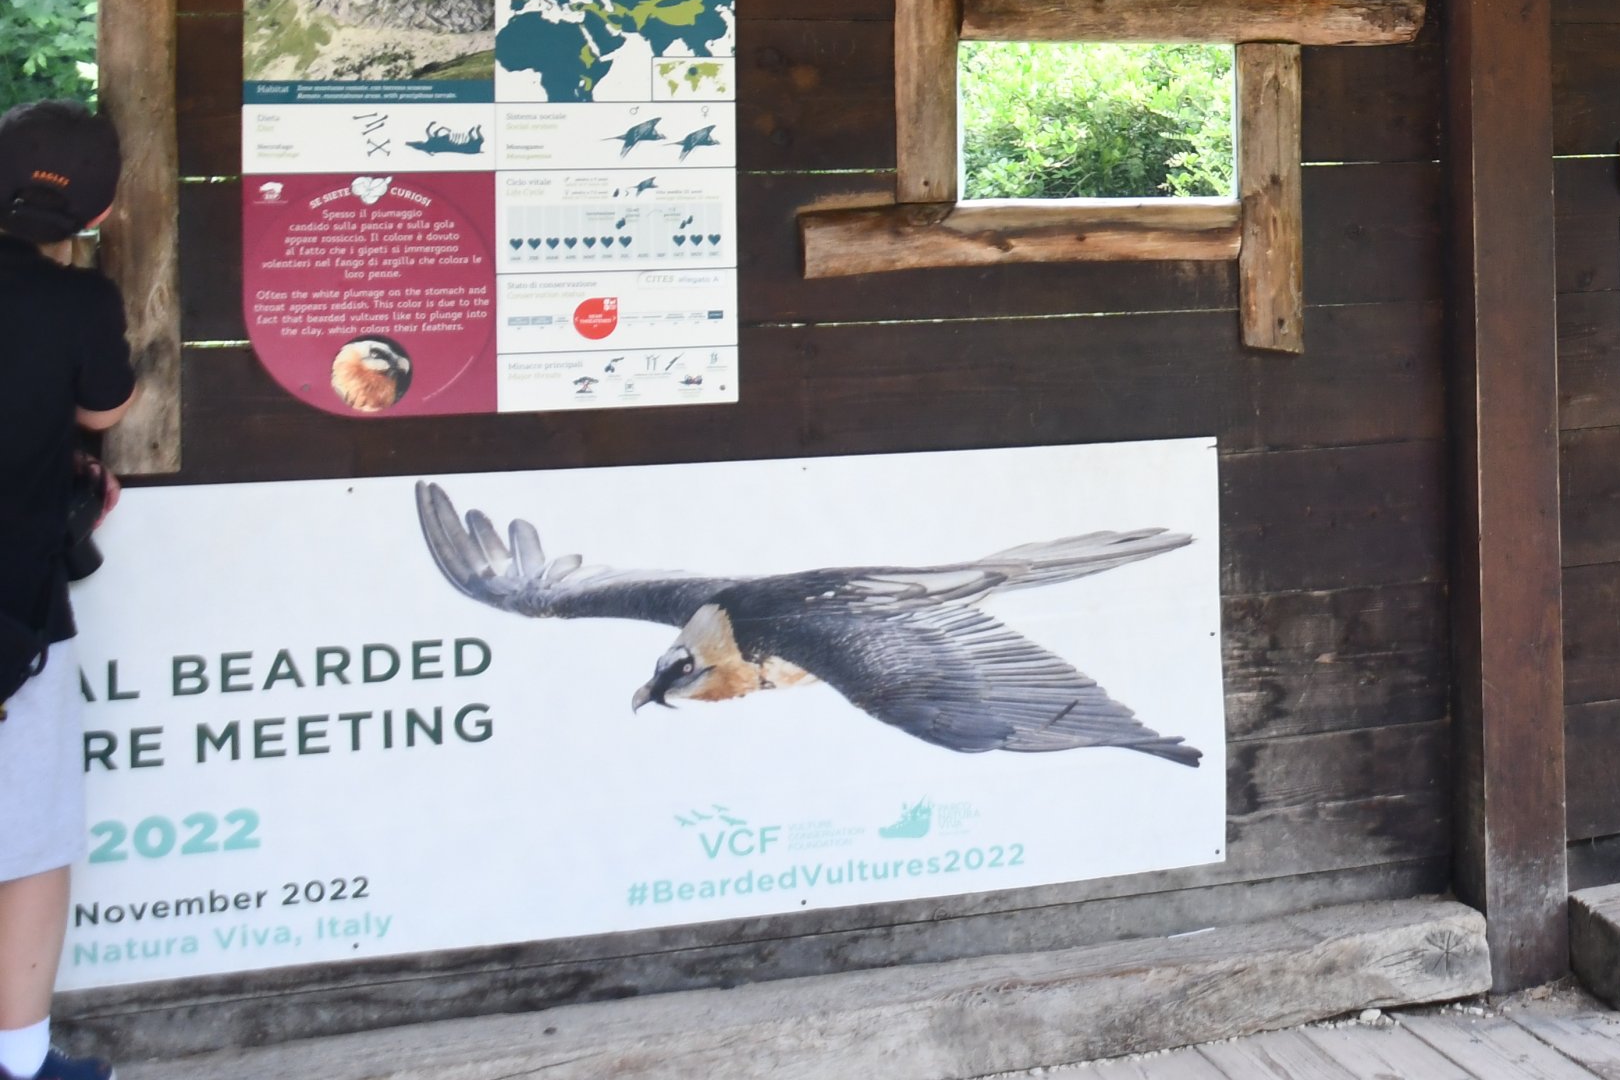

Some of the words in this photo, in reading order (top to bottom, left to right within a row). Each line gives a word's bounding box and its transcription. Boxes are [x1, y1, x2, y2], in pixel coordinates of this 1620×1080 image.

[257, 85, 289, 93] Habitat
[506, 113, 537, 121] Sistema
[506, 178, 527, 186] Ciclo
[529, 178, 551, 186] vitale
[310, 197, 322, 209] SE
[323, 187, 351, 202] SIETE
[390, 187, 432, 206] CURIOSI
[322, 210, 355, 221] Spesso
[360, 209, 367, 218] il
[371, 209, 423, 220] piumaggio
[289, 222, 330, 231] candido
[333, 222, 356, 230] sulla
[361, 222, 393, 232] pancia
[407, 220, 430, 229] sulla
[434, 220, 455, 230] gola
[285, 236, 317, 246] appare
[321, 234, 366, 243] rossiccio.
[371, 233, 378, 241] Il
[384, 232, 413, 241] colore
[426, 232, 460, 240] dovuto
[286, 247, 295, 256] al
[300, 247, 326, 255] fatto
[329, 246, 346, 254] che
[358, 246, 387, 256] gipeti
[404, 245, 458, 255] immergono
[262, 259, 310, 269] volentieri
[315, 258, 330, 267] nel
[335, 257, 364, 268] fango
[368, 258, 378, 266] di
[383, 256, 415, 268] argilla
[419, 256, 435, 264] che
[439, 256, 469, 264] colora
[473, 255, 482, 263] le
[344, 270, 364, 279] loro
[368, 271, 401, 281] penne.
[645, 275, 674, 283] CITES
[507, 281, 527, 290] Stato
[529, 280, 536, 289] di
[537, 280, 597, 290] conservazione
[256, 290, 287, 300] Often
[292, 290, 308, 299] the
[312, 290, 339, 298] white
[344, 289, 384, 300] plumage
[405, 288, 421, 296] the
[425, 287, 465, 295] stomach
[469, 286, 486, 294] and
[254, 304, 285, 312] throat
[290, 303, 327, 313] appears
[331, 301, 369, 310] reddish.
[374, 300, 393, 308] This
[397, 300, 421, 308] color
[426, 299, 434, 307] is
[438, 299, 455, 307] due
[256, 315, 277, 324] fact
[282, 315, 302, 323] that
[307, 314, 345, 322] bearded
[351, 313, 389, 322] vultures
[393, 312, 411, 320] like
[430, 311, 463, 321] plunge
[467, 310, 487, 318] into
[281, 327, 297, 336] the
[301, 326, 324, 336] clay,
[328, 326, 356, 334] which
[361, 325, 390, 333] colors
[394, 323, 418, 332] their
[422, 323, 464, 331] feathers.
[508, 362, 542, 370] Minacce
[544, 361, 583, 371] principali
[171, 637, 494, 698] BEARDED
[196, 702, 495, 765] MEETING
[87, 809, 262, 865] 2022
[698, 825, 781, 860] VCF
[626, 843, 1026, 908] #BeardedVultures2022
[75, 888, 268, 928] November
[281, 877, 370, 907] 2022
[73, 934, 199, 967] Natura
[213, 923, 302, 952] Viva,
[317, 914, 394, 943] Italy
